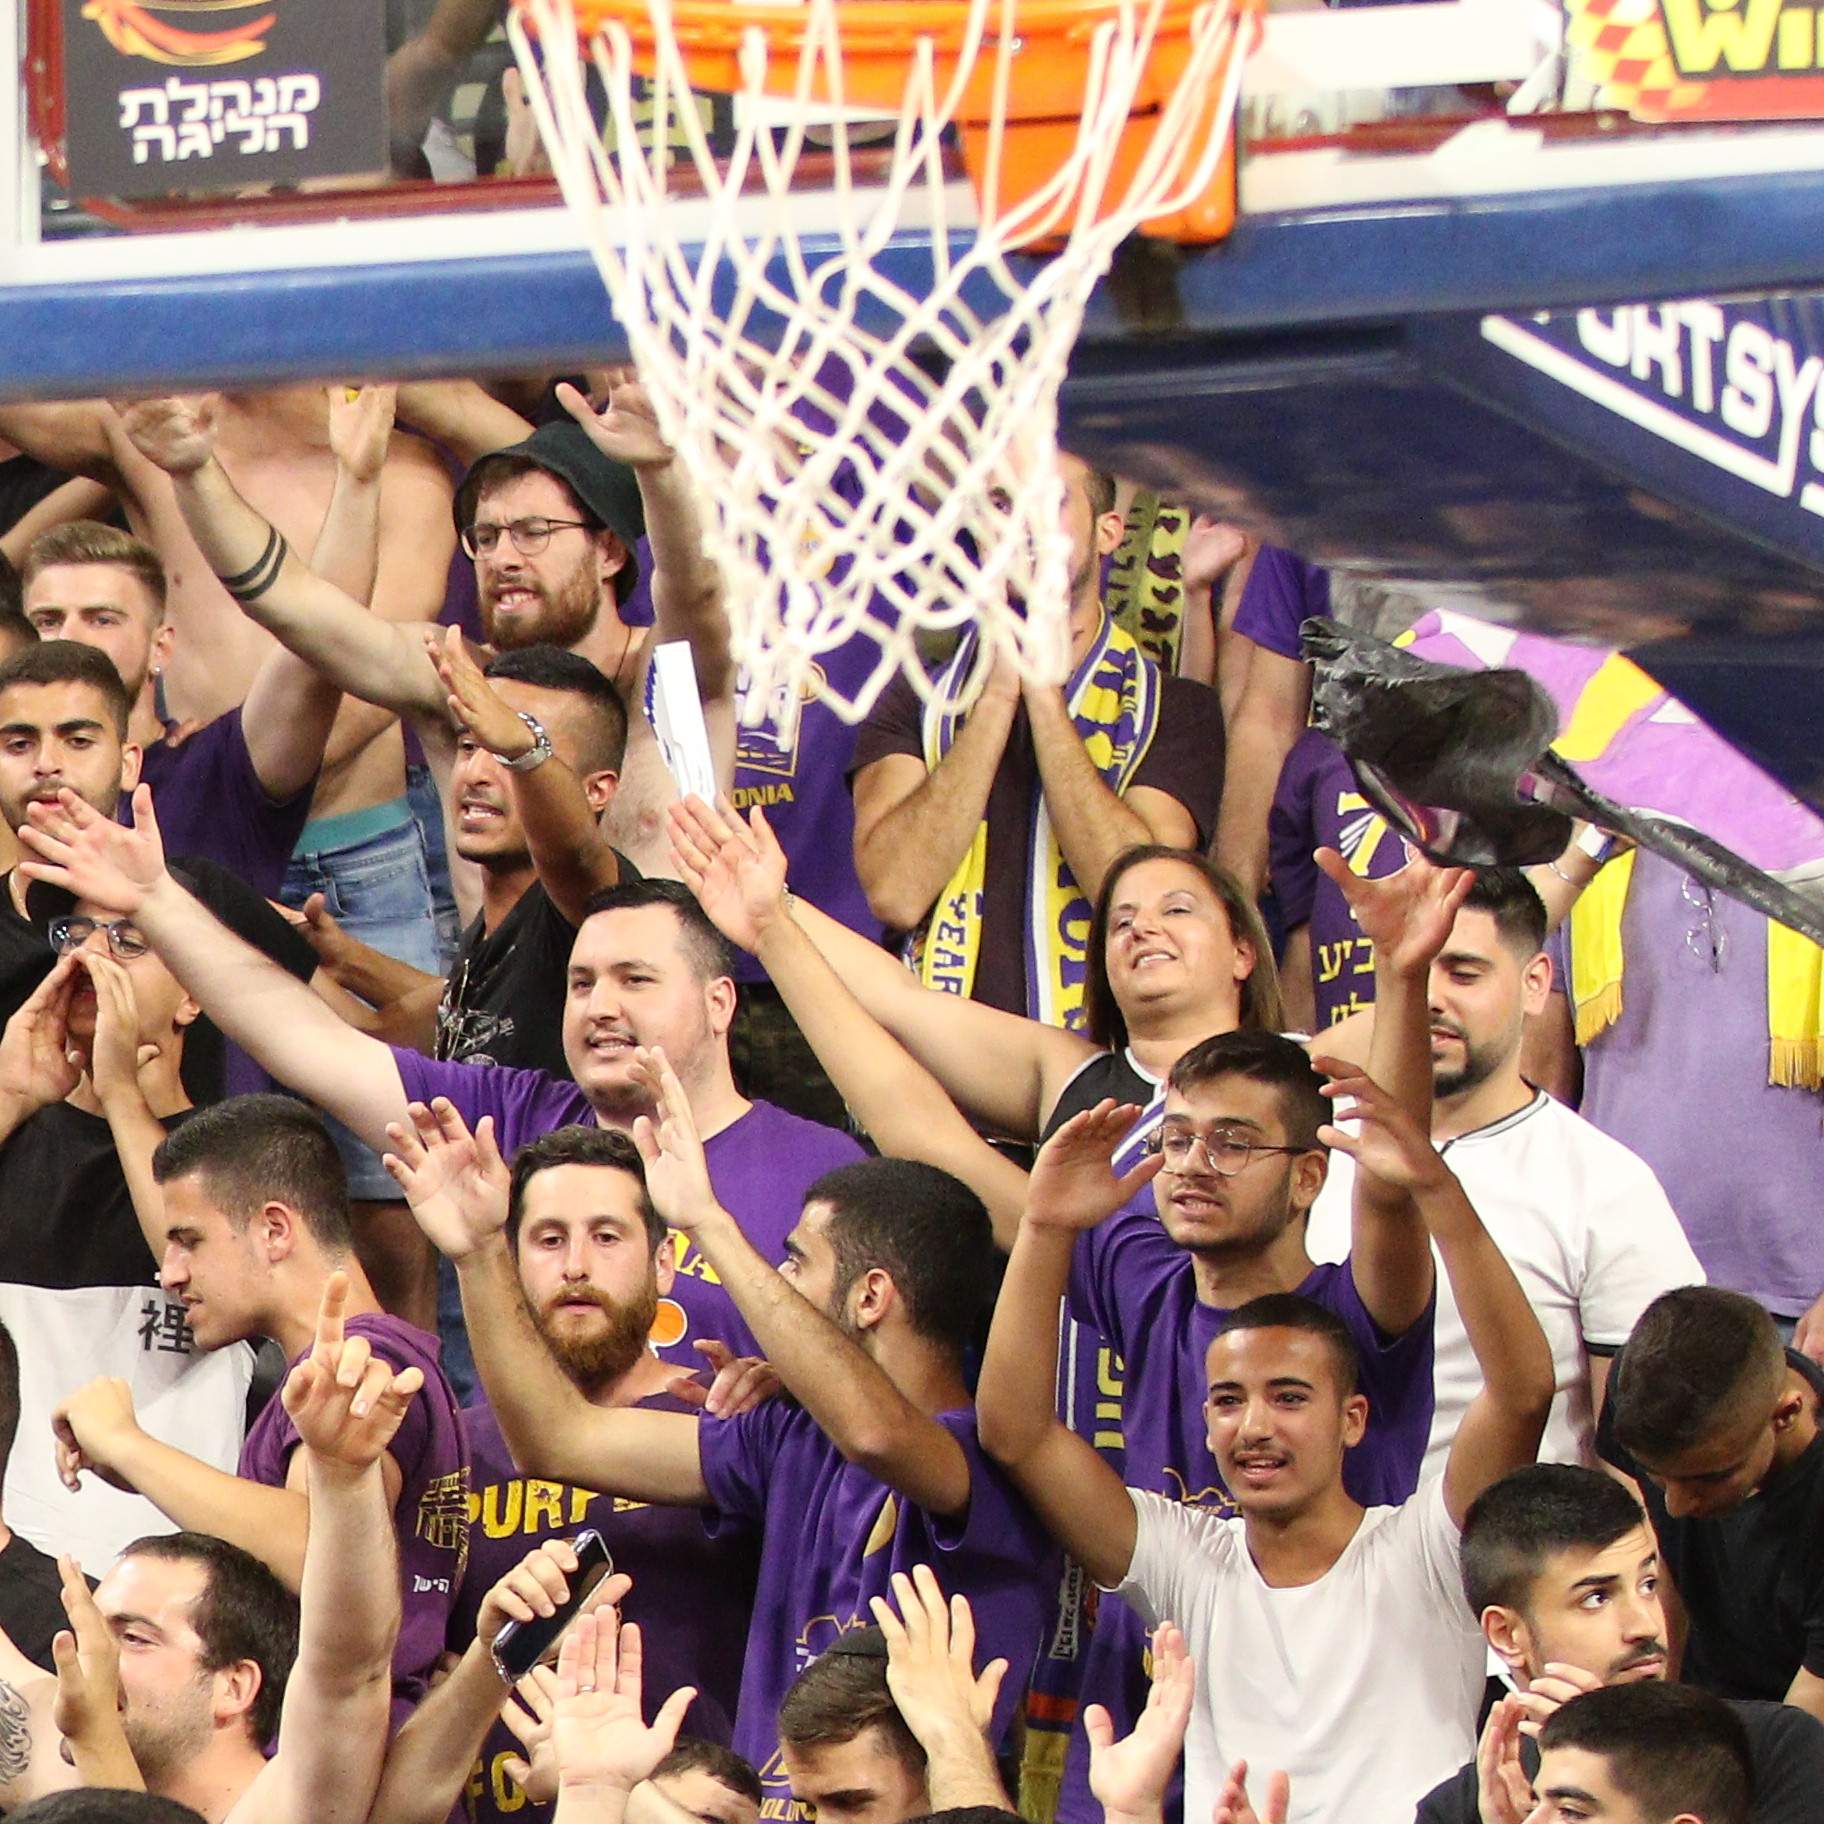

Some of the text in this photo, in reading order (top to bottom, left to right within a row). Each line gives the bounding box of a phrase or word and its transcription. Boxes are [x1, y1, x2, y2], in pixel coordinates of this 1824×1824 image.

[119, 73, 320, 129] מנהלת
[132, 112, 309, 164] הליגה
[730, 782, 794, 808] ONIA
[932, 892, 969, 998] YEAR
[758, 1796, 818, 1823] OLON
